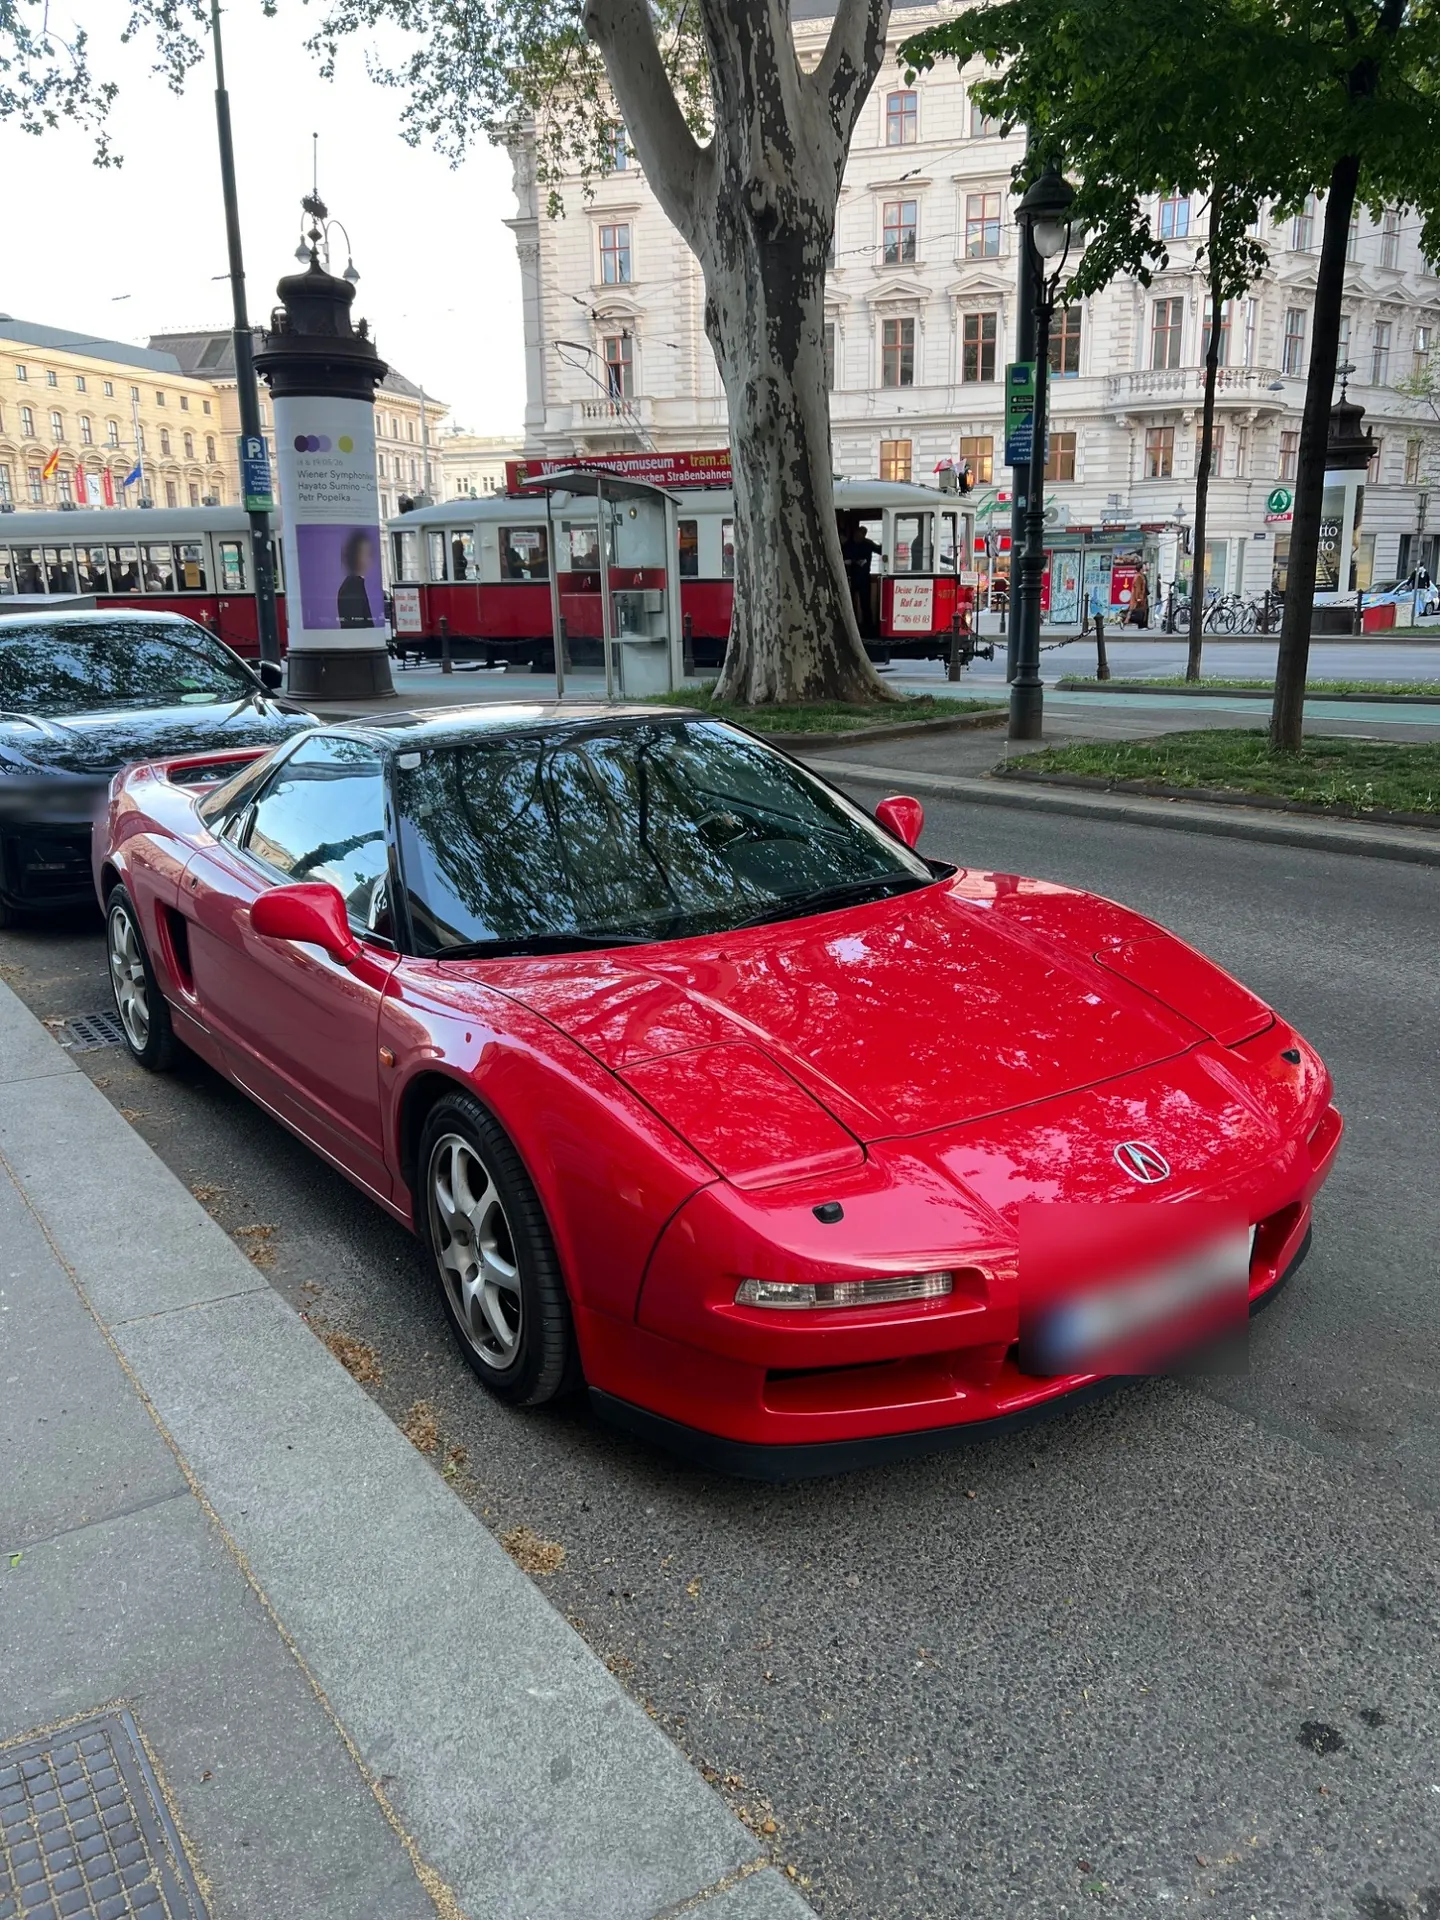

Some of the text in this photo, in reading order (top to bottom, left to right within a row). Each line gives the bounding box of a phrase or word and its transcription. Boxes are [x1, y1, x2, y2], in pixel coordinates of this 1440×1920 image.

[689, 453, 732, 467] tram.at
[298, 469, 328, 479] Wiener
[667, 469, 732, 482] Straßenbahnen
[298, 482, 328, 491] Hayato
[329, 481, 360, 491] Sumino
[298, 493, 351, 502] Petr Popelka
[632, 571, 643, 585] A1
[895, 585, 911, 594] Deine
[900, 597, 914, 607] Ruf
